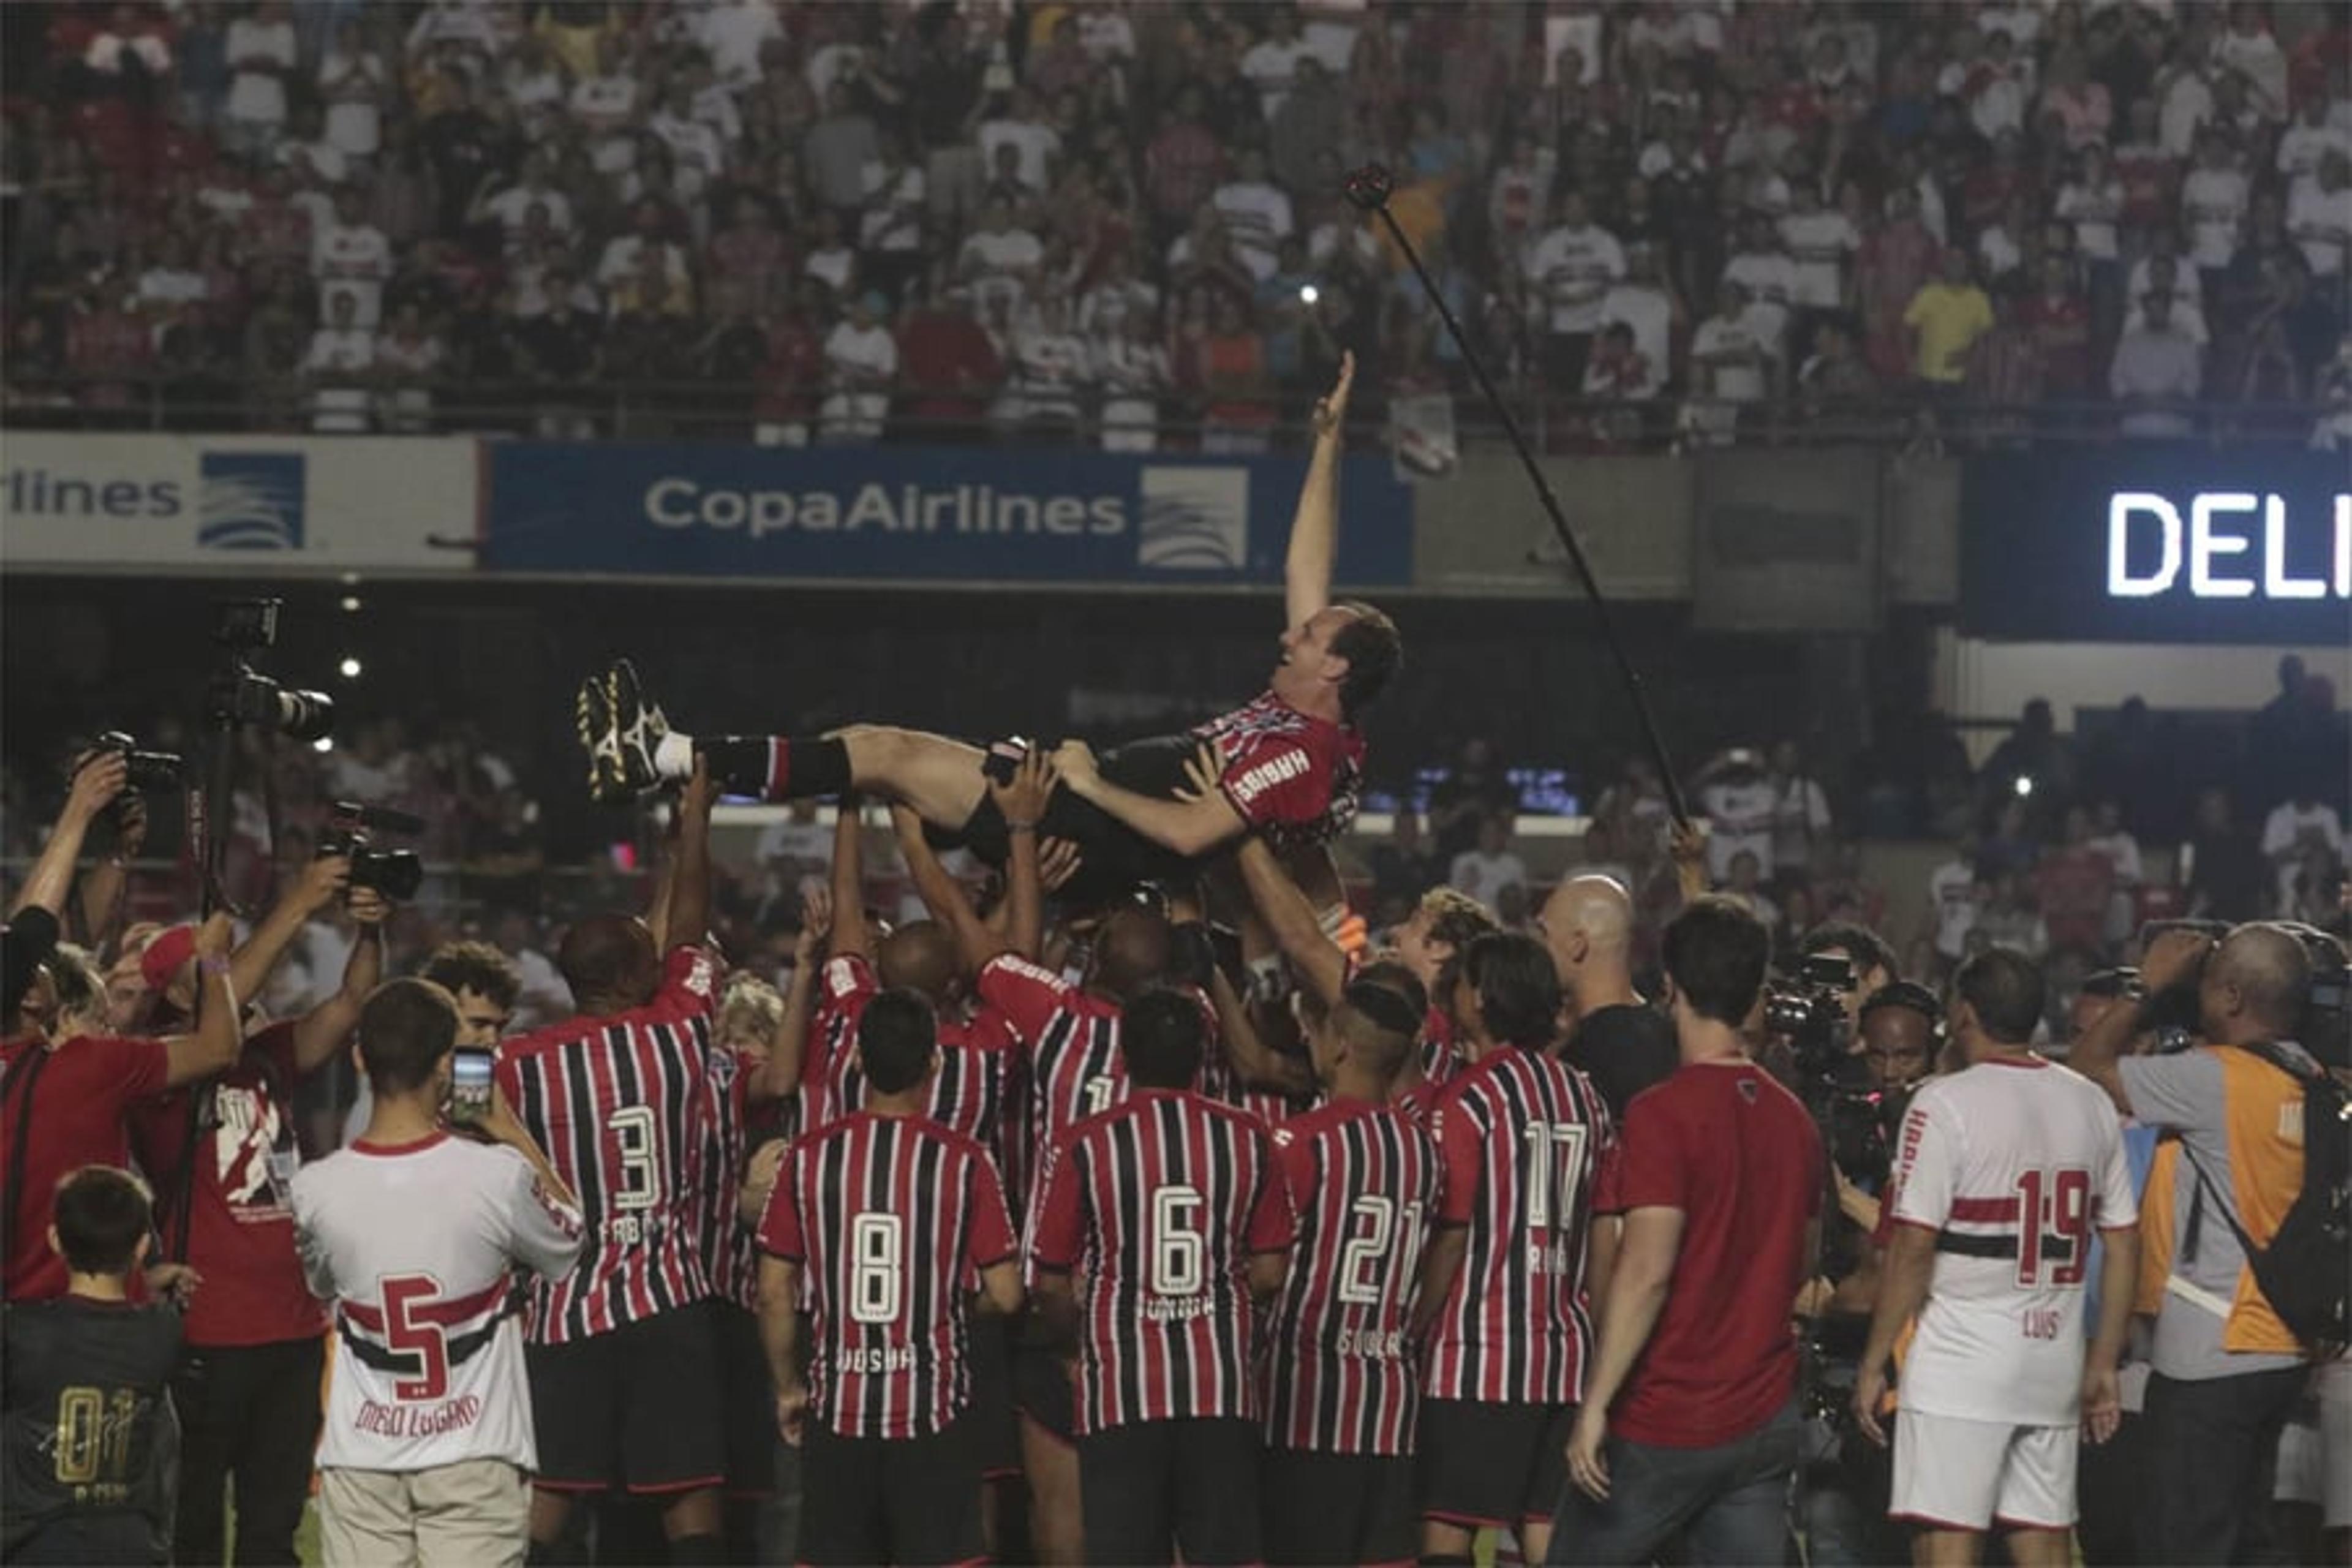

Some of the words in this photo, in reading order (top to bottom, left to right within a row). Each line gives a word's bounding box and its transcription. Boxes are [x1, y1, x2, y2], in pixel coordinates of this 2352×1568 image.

[0, 468, 181, 517] lines
[608, 1105, 661, 1210] 3
[1523, 1121, 1588, 1229] 17
[851, 1212, 902, 1324] 8
[1152, 1185, 1203, 1296] 6
[1337, 1196, 1423, 1306] 21
[2016, 1167, 2090, 1289] 19
[379, 1273, 450, 1405] 5
